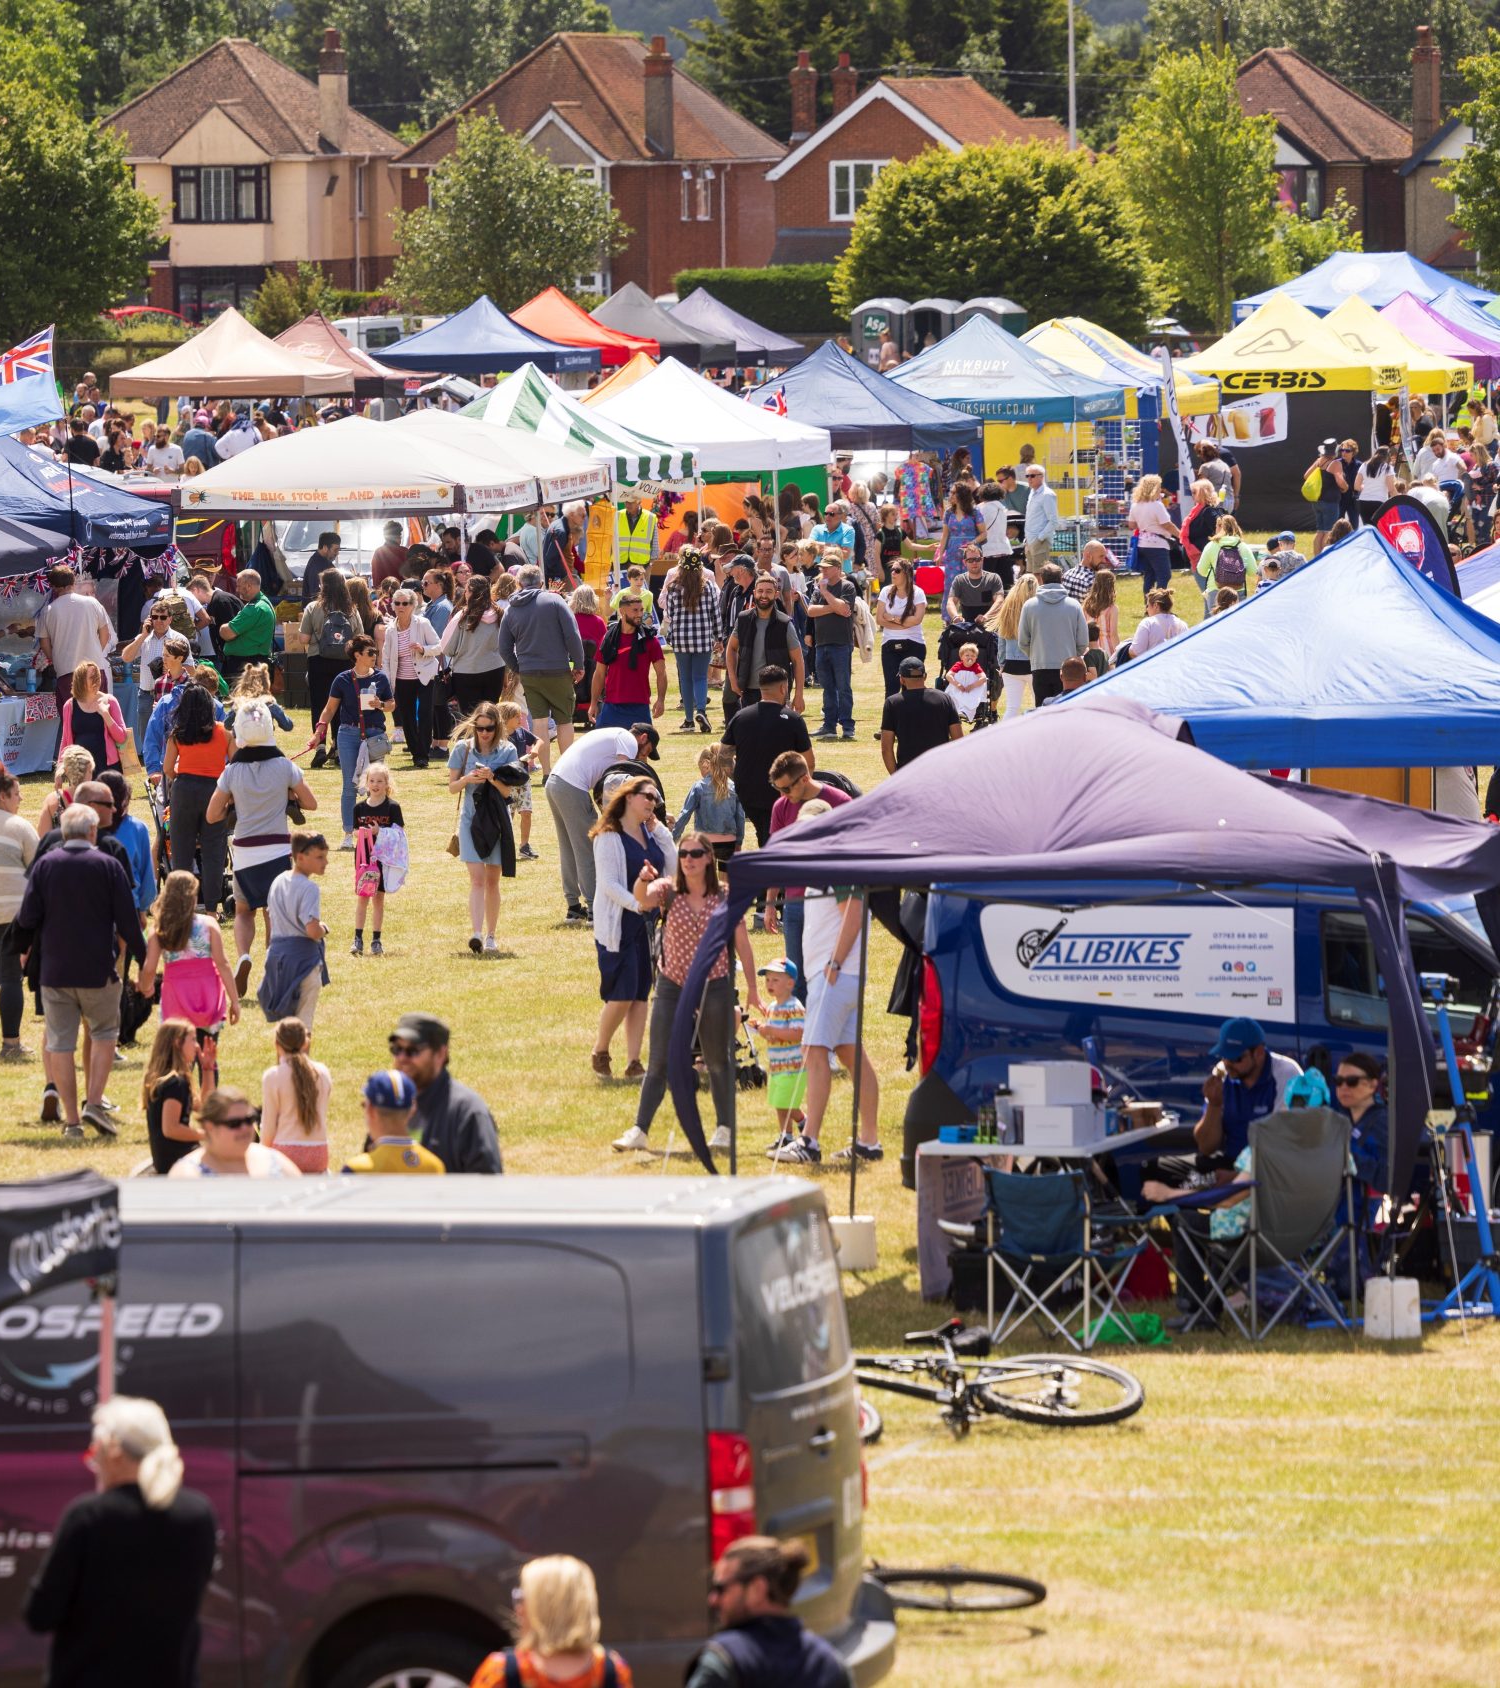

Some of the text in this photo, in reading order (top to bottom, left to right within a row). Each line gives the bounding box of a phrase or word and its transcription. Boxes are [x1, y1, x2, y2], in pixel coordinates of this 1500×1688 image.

[943, 360, 1010, 371] NEWBURY
[231, 491, 254, 500] THE
[260, 492, 285, 501] BUG
[291, 492, 329, 501] STORE
[381, 489, 421, 499] MORE!
[1037, 940, 1185, 964] ALIBIKES
[1029, 974, 1180, 982] CYCLE REPAIR AND SERVICING
